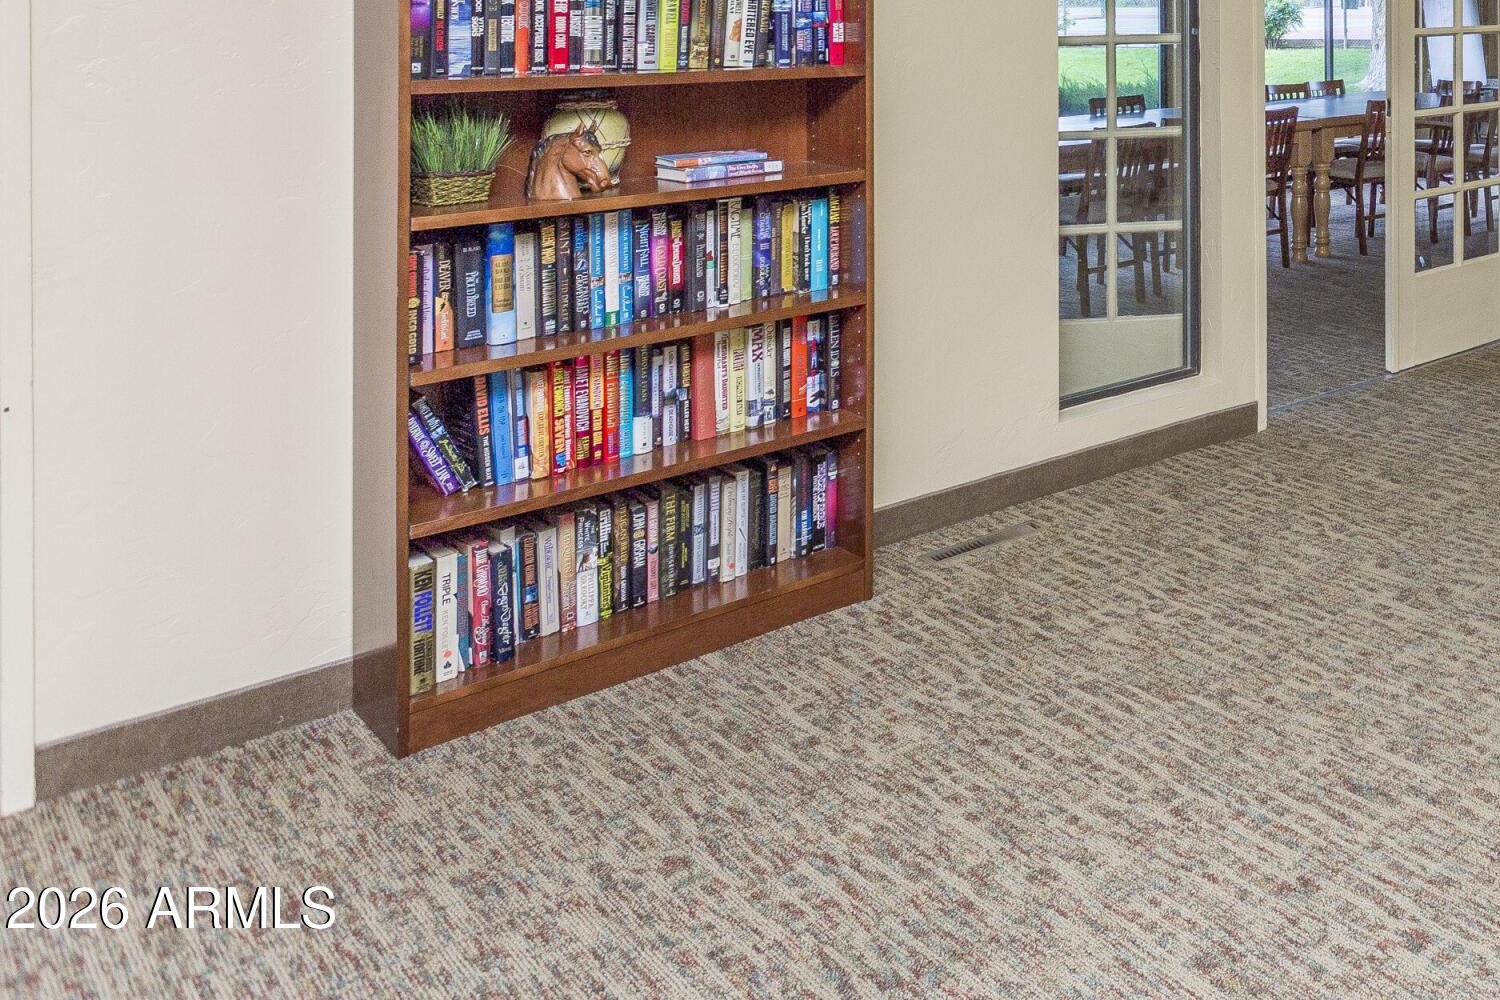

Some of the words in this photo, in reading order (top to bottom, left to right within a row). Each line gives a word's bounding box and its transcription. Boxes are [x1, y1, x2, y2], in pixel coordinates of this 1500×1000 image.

[519, 0, 529, 29] COOK
[554, 16, 567, 33] ROBIN
[606, 4, 616, 20] FIRE
[622, 14, 636, 24] THE
[501, 14, 514, 44] TERMINAL
[534, 14, 544, 48] ACCEPTABLE
[554, 34, 567, 49] COOK
[584, 15, 603, 50] CONTAGION
[622, 24, 636, 37] LAST
[644, 24, 656, 56] SCARPETTA
[534, 48, 544, 63] RISK
[622, 38, 636, 64] PRECINCT
[744, 40, 756, 55] EYE
[730, 199, 740, 241] RAGTIME
[559, 222, 570, 256] SAINT
[575, 222, 584, 253] DEKKER
[636, 223, 650, 250] NIGHT
[636, 250, 650, 268] FALL
[438, 259, 451, 292] DEAVER
[465, 270, 480, 294] PROUD
[542, 268, 556, 282] LEN
[560, 279, 570, 293] TED
[465, 294, 480, 318] BREED
[542, 282, 556, 317] DEIGHTON
[560, 294, 570, 322] DEKKER
[751, 326, 764, 363] MAX
[766, 325, 774, 358] Outsider
[830, 314, 840, 350] FALLEN
[606, 355, 619, 380] JANET
[640, 344, 649, 379] NICHOLAS
[575, 366, 590, 388] JANET
[640, 381, 649, 402] EVANS
[474, 376, 488, 408] DAVID
[606, 382, 619, 428] EVANOVICH
[476, 407, 490, 436] ELLIS
[575, 390, 590, 432] EVANOVICH
[593, 408, 603, 431] METRO
[554, 418, 564, 454] SEVEN
[593, 431, 603, 446] GIRL
[556, 452, 566, 467] UP
[817, 461, 826, 492] THUNDER
[666, 494, 676, 516] THE
[817, 492, 826, 503] OF
[600, 508, 612, 542] Griffin
[619, 506, 630, 540] PELICAN
[633, 512, 646, 531] JOHN
[666, 518, 676, 542] FIRM
[473, 548, 489, 566] JULIE
[619, 541, 630, 563] BRIEF
[633, 538, 646, 569] GRISHAM
[414, 568, 432, 593] KEN
[442, 572, 451, 606] TRIPLE
[473, 566, 489, 597] GARWOOD
[580, 575, 588, 610] GREGORY
[600, 562, 612, 609] Vigilantes
[414, 590, 432, 633] FOLLETT
[414, 638, 426, 676] FORTUNE
